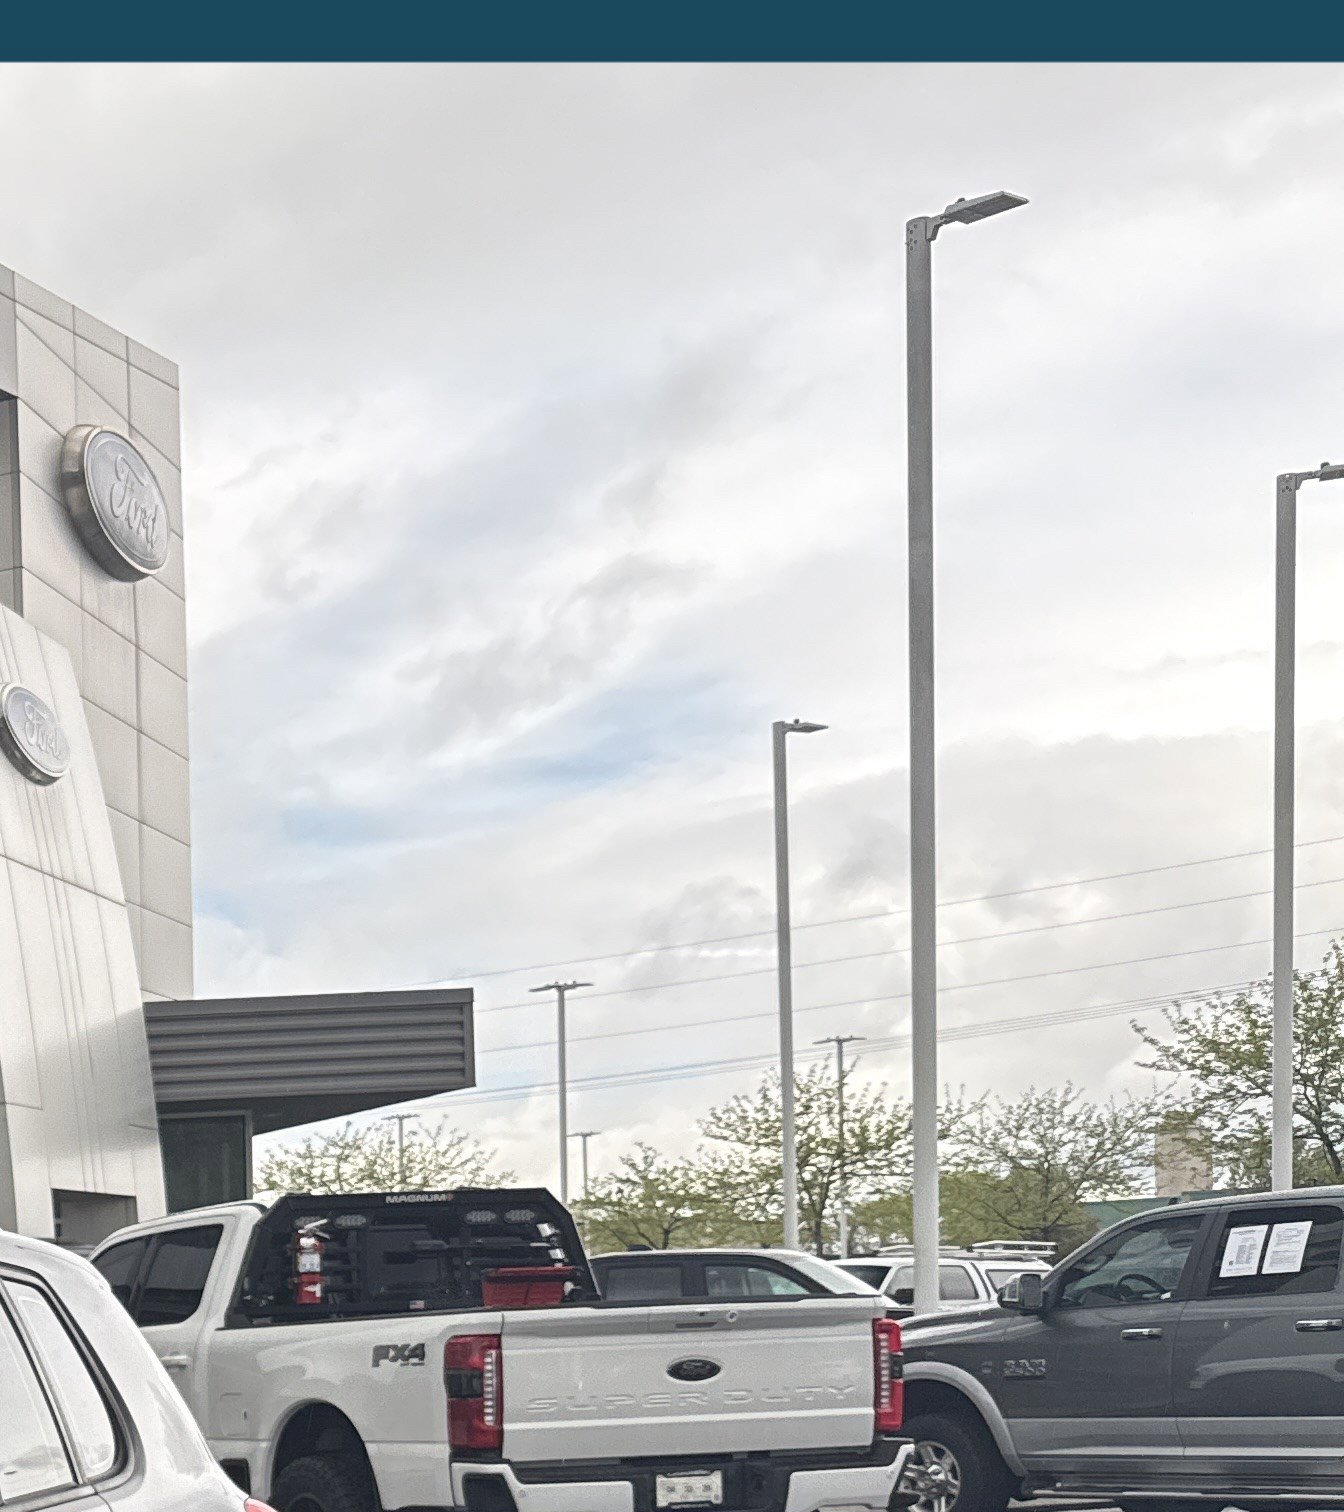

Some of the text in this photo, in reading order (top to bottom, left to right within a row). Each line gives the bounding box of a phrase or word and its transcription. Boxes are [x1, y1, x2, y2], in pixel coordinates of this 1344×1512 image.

[110, 453, 161, 550] Ford
[24, 700, 64, 760] Ford
[372, 1343, 425, 1367] FX4
